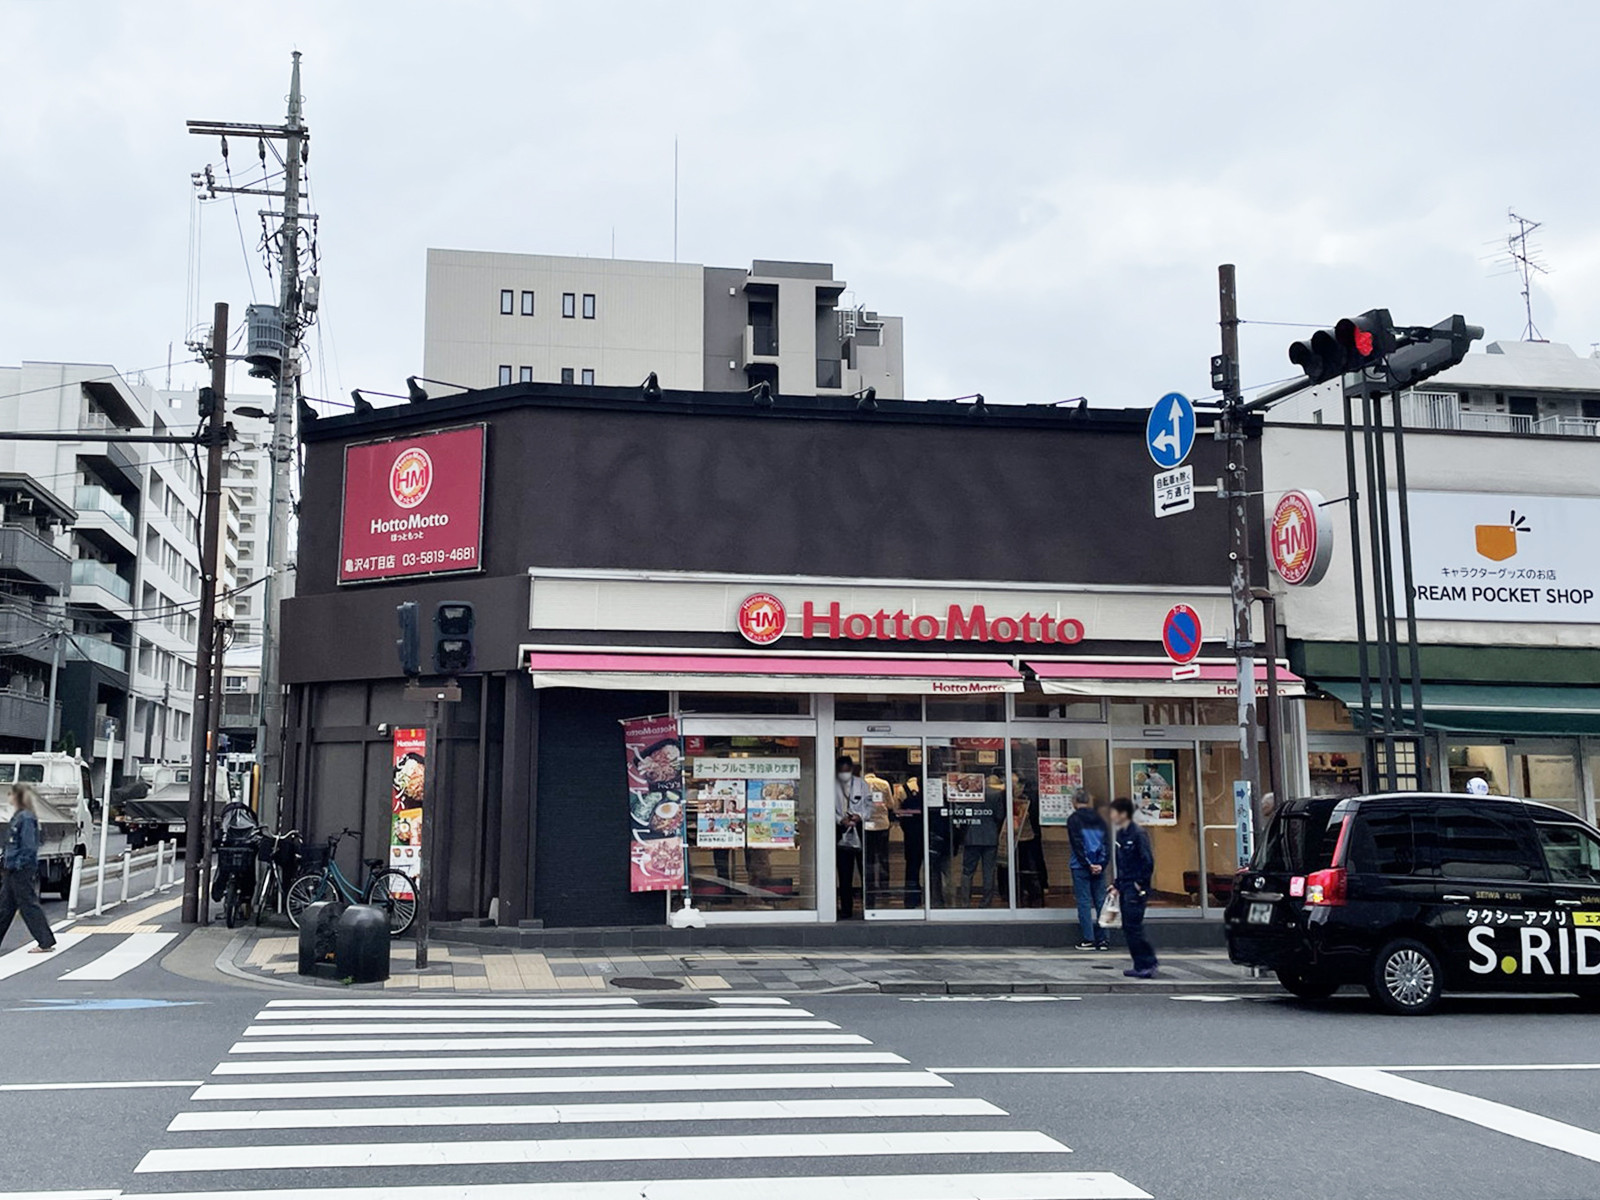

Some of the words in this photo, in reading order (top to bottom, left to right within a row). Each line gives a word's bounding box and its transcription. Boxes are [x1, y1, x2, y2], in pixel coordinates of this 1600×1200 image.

[396, 469, 426, 491] HM
[1156, 471, 1190, 489] 自転車を除く
[1157, 484, 1190, 500] 一方通行
[1273, 496, 1308, 527] HottoMotto
[370, 513, 449, 534] HottoMotto
[390, 531, 424, 542] ほっともっと
[1275, 521, 1310, 559] HM
[345, 556, 396, 572] 亀沢4丁目店
[402, 547, 475, 566] 03-5819-4681
[1441, 567, 1557, 580] キャラクターグッズのお店
[1472, 586, 1541, 603] POCKET
[1546, 588, 1594, 604] SHOP
[744, 611, 781, 628] HM
[802, 601, 1085, 644] HottoMotto
[932, 682, 1005, 692] HottoMotto
[1466, 908, 1566, 925] タクシーアプリ
